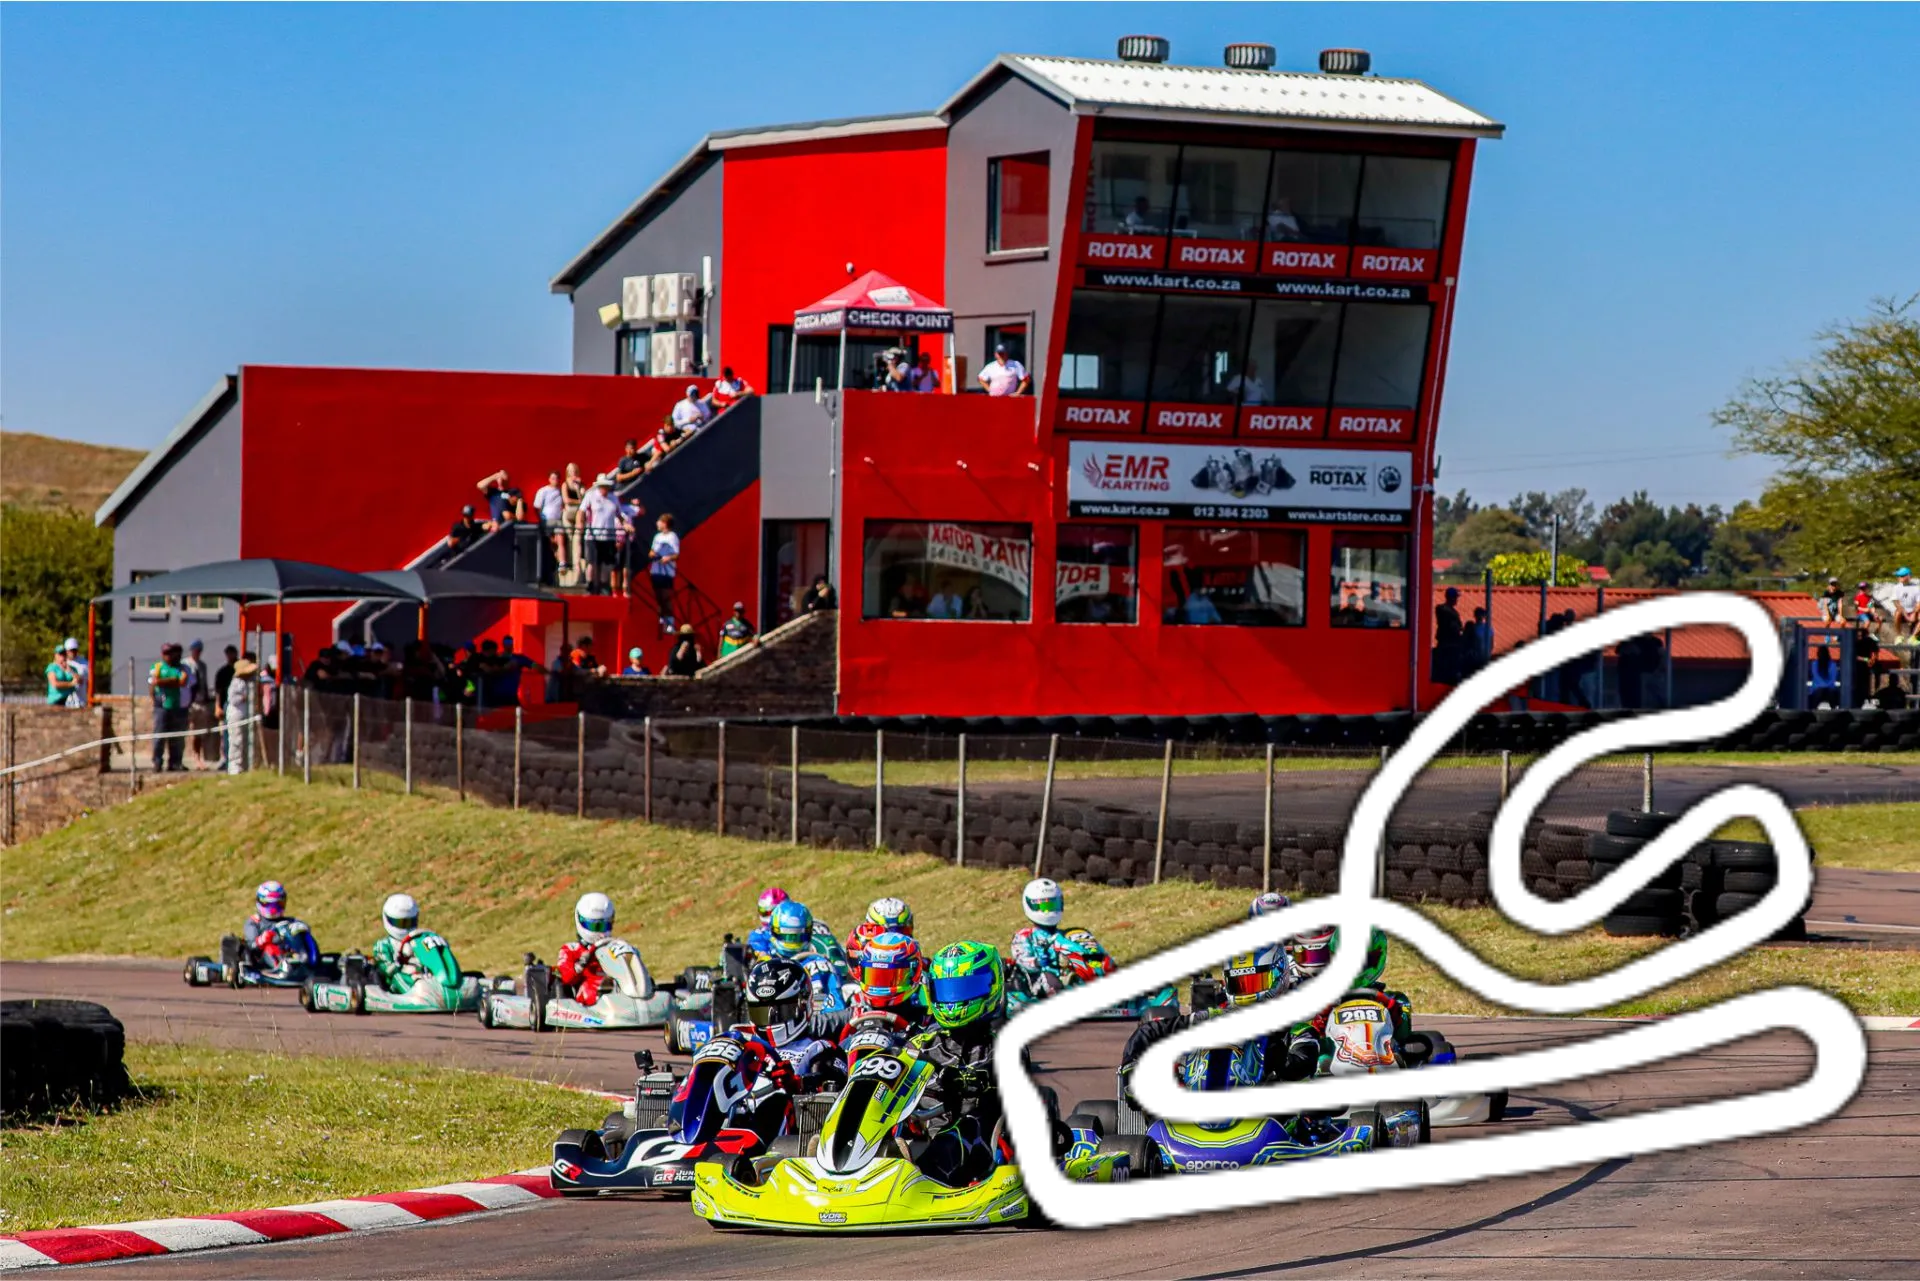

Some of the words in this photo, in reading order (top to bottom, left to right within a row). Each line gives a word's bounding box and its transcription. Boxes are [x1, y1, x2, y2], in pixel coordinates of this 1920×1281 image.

[1088, 242, 1153, 259] ROTAX
[1181, 247, 1245, 264] ROTAX
[1272, 251, 1336, 268] ROTAX
[1362, 255, 1425, 272] ROTAX
[1103, 273, 1241, 290] www.kart.co.za
[1276, 282, 1411, 298] www.kart.co.za
[848, 310, 901, 326] CHECK
[905, 314, 951, 328] POINT
[1065, 406, 1131, 424] ROTAX
[1158, 410, 1223, 428] ROTAX
[1250, 414, 1313, 431] ROTAX
[1339, 416, 1402, 433] ROTAX
[1103, 454, 1170, 479] EMR
[1102, 479, 1170, 491] KARTING
[1309, 470, 1367, 486] ROTAX
[1080, 503, 1170, 516] www.kart.co.za
[1193, 507, 1214, 517] 012
[1287, 510, 1402, 522] www.kartstore.co.za
[1229, 967, 1256, 977] sparco
[692, 1041, 742, 1063] 258
[849, 1057, 902, 1081] 299
[556, 1159, 583, 1181] GR
[1186, 1160, 1240, 1174] sparco
